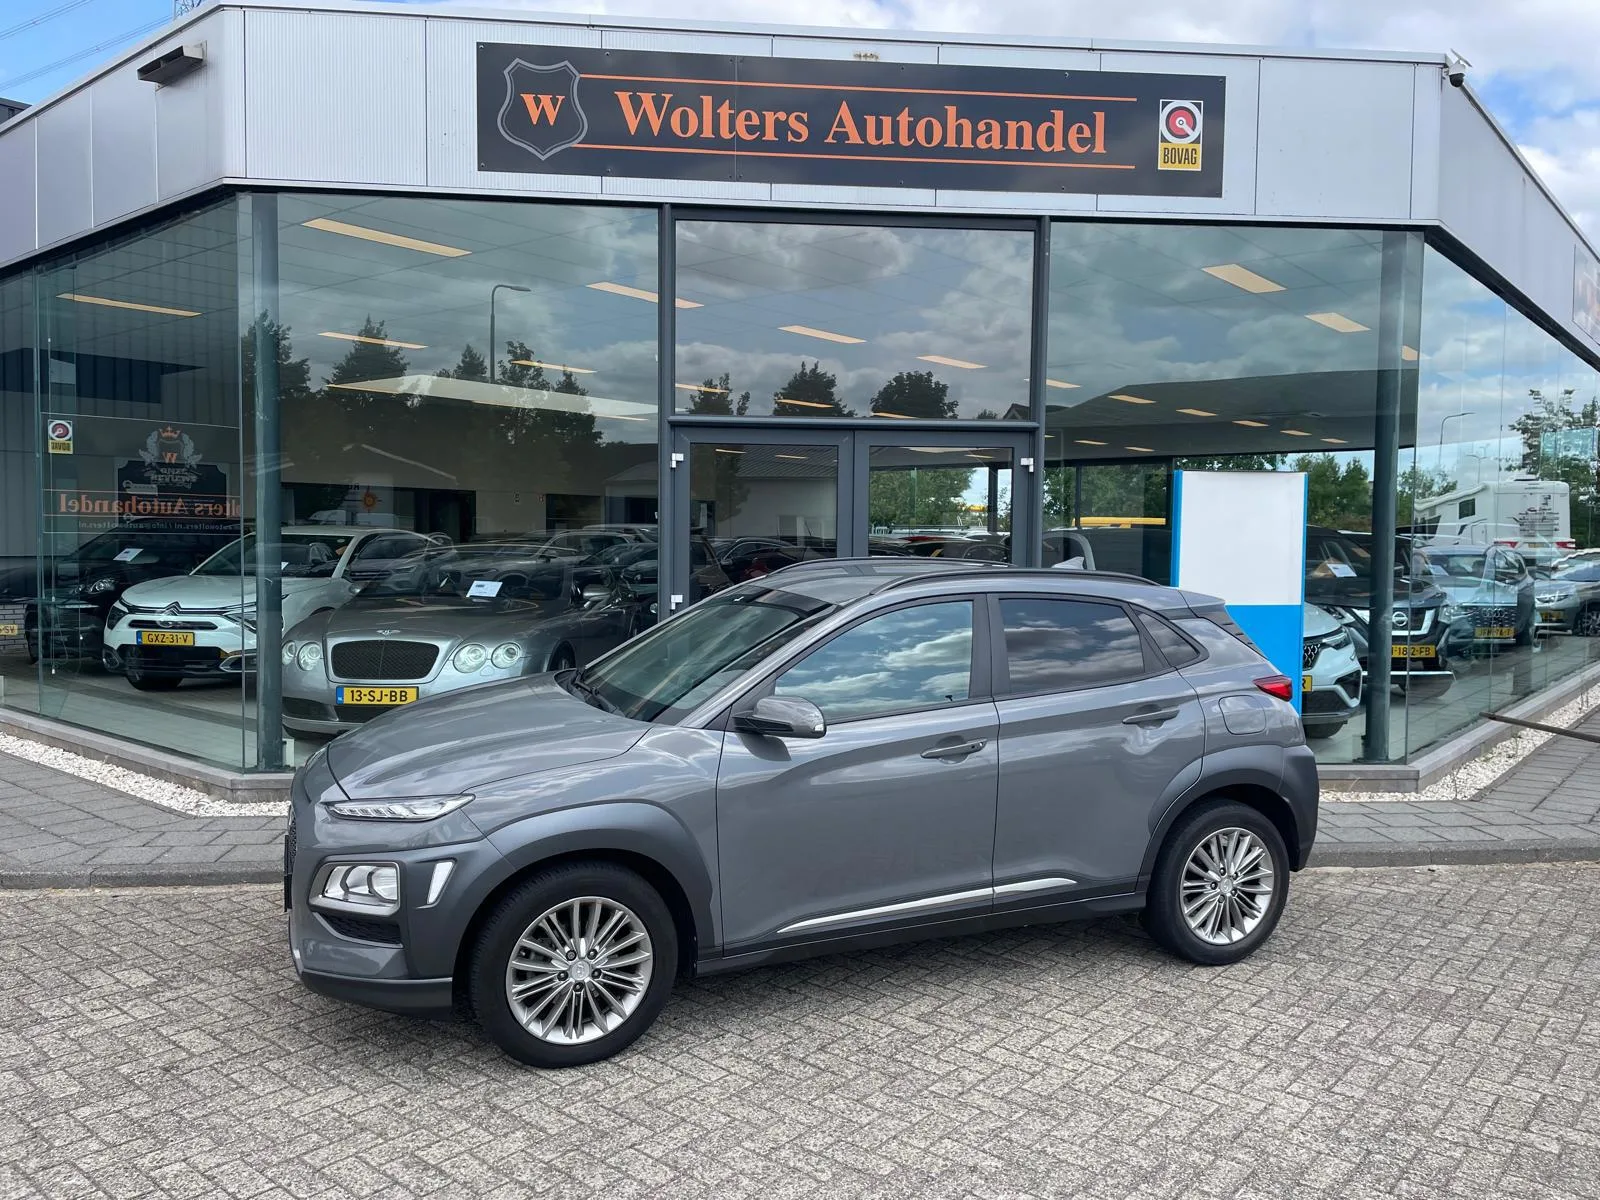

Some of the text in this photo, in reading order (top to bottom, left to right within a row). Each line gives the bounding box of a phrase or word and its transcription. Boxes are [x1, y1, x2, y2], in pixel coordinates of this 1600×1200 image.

[519, 93, 566, 127] W
[614, 91, 1107, 154] Wolters Autohandel
[1162, 147, 1198, 165] BOVAG
[147, 633, 189, 644] GXZ-31-V
[350, 689, 408, 702] 13-SJ-BB
